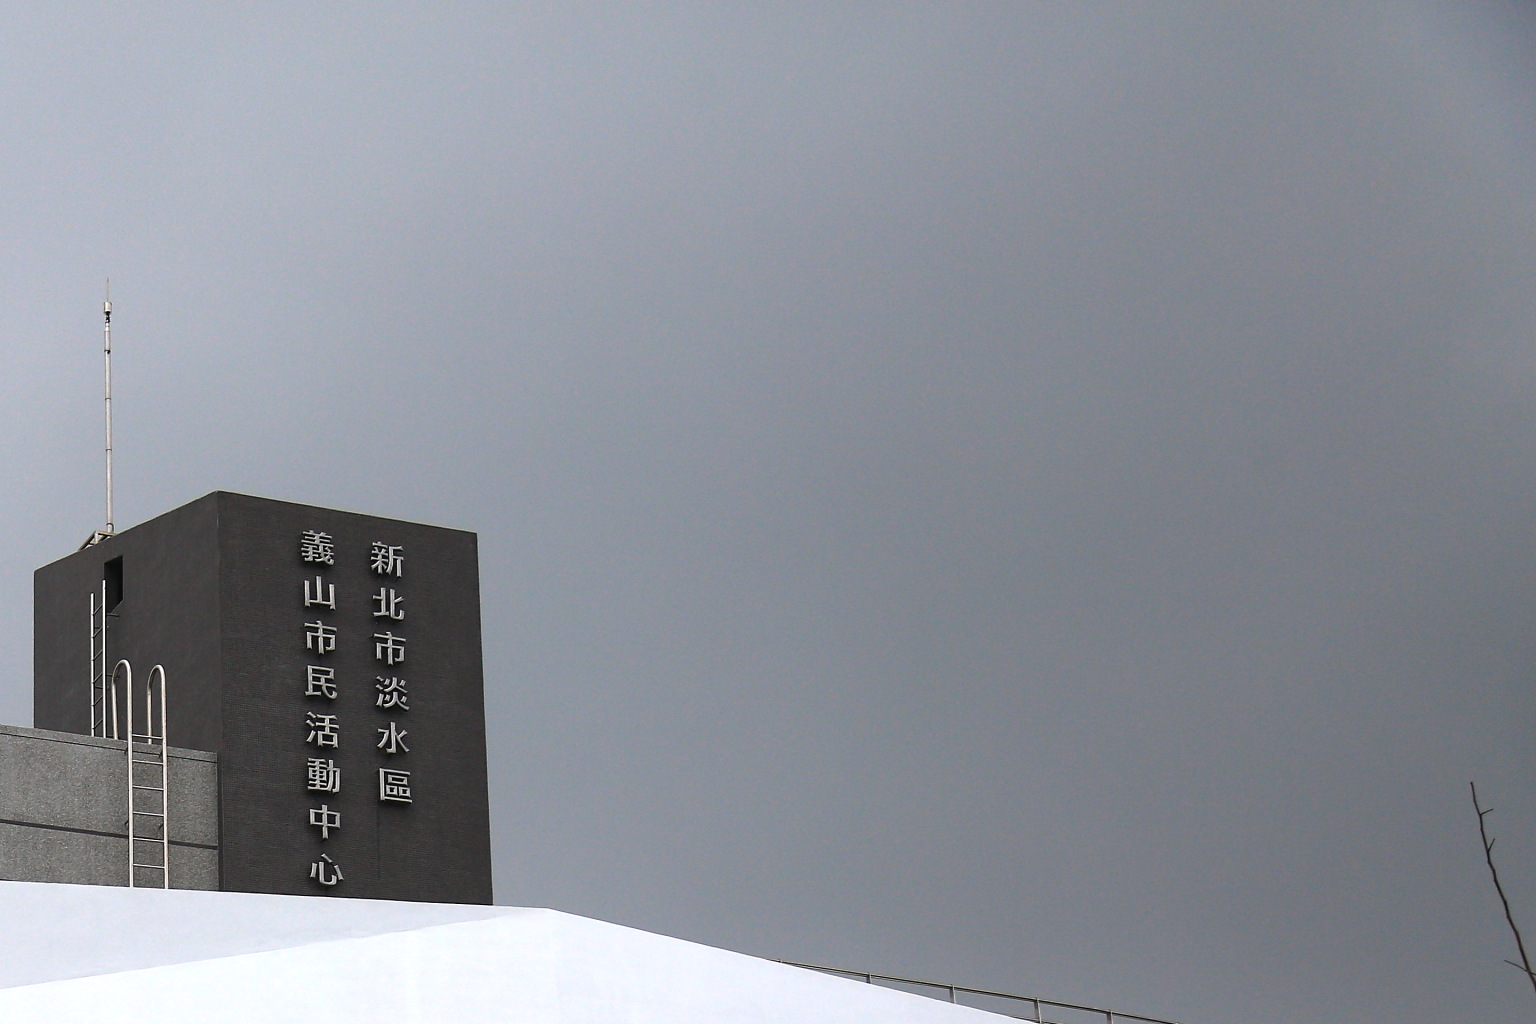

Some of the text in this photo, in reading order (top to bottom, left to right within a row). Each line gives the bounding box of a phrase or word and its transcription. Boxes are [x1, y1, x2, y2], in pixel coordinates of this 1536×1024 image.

[301, 530, 344, 887] 義山市民活動中心
[371, 541, 413, 803] 新北市淡水區
